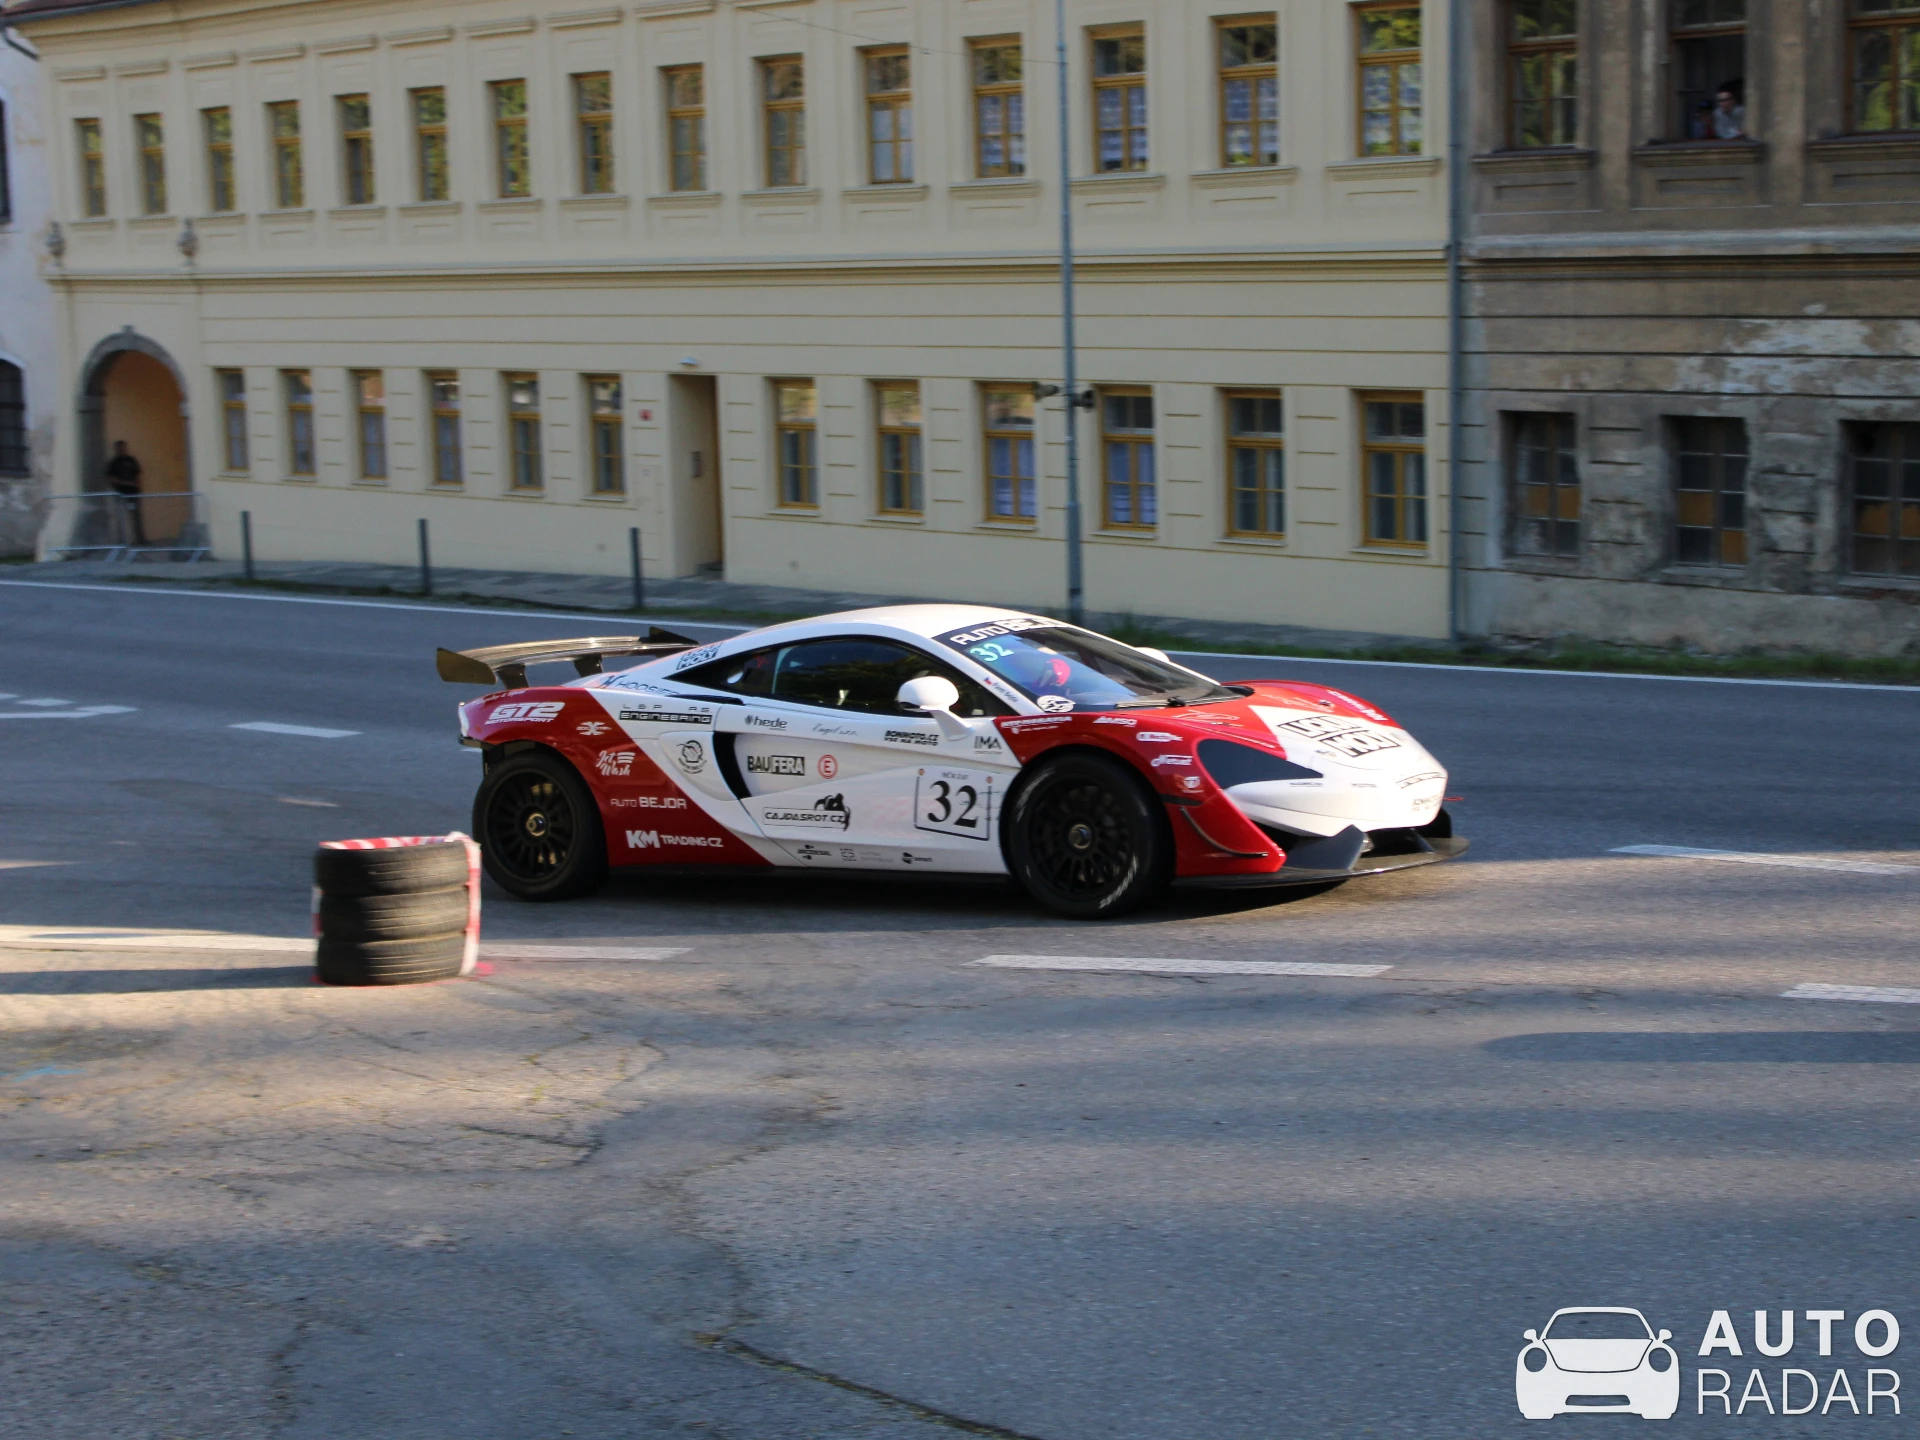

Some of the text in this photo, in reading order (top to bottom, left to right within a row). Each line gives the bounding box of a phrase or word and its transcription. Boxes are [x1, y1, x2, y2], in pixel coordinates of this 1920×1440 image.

[950, 625, 1010, 645] AUTO
[969, 643, 1014, 662] 32
[489, 701, 565, 720] GT2
[753, 715, 787, 729] hede
[927, 780, 978, 829] 32
[625, 830, 661, 849] KM
